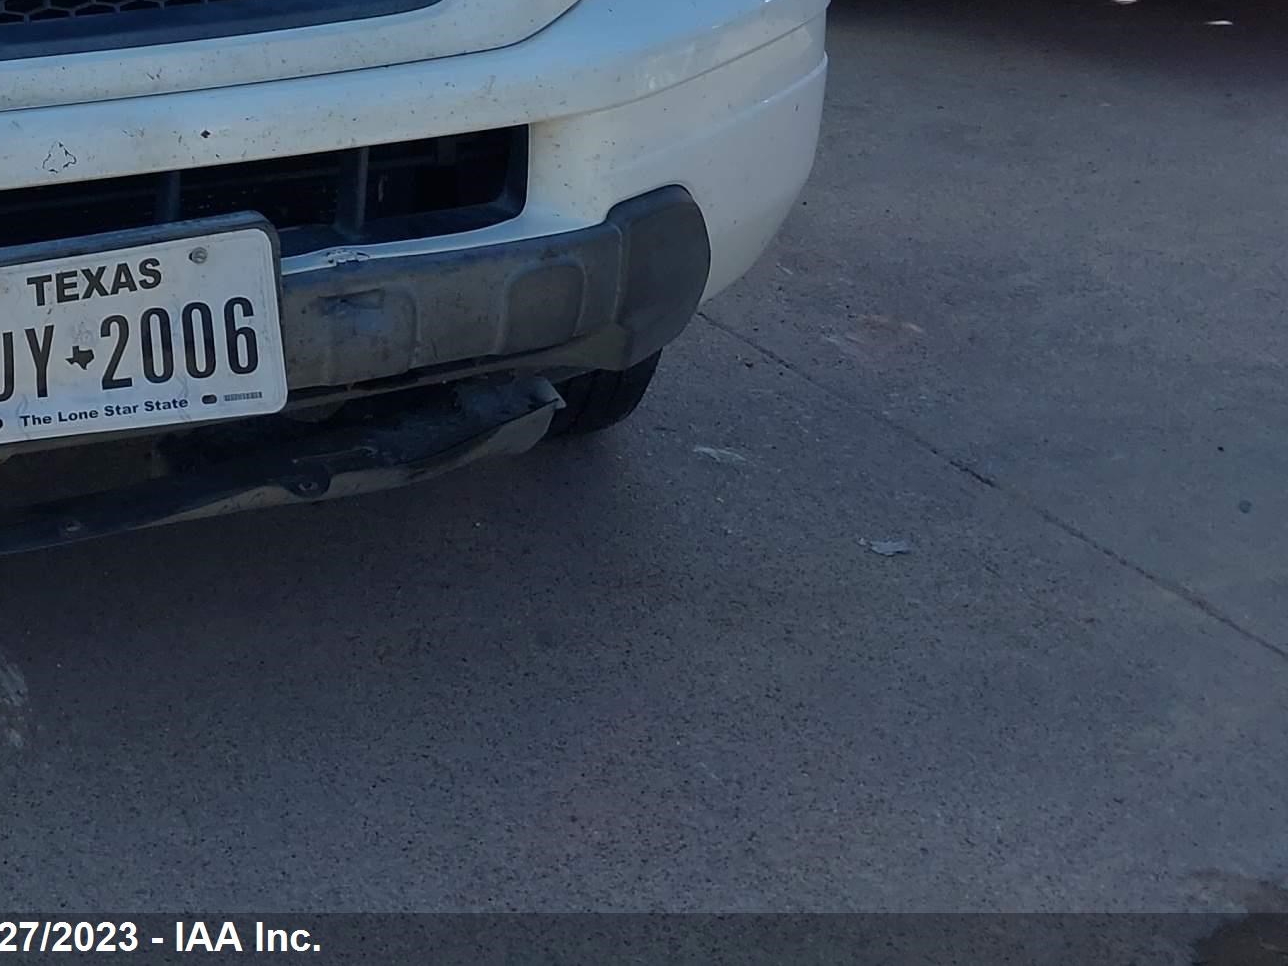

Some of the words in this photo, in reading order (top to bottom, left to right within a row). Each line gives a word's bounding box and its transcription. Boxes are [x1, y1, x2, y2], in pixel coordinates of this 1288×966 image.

[26, 257, 162, 307] TEXAS
[100, 297, 260, 391] 2006
[20, 415, 52, 427] The
[58, 408, 100, 423] Lone
[104, 405, 140, 417] Star
[144, 397, 189, 412] State
